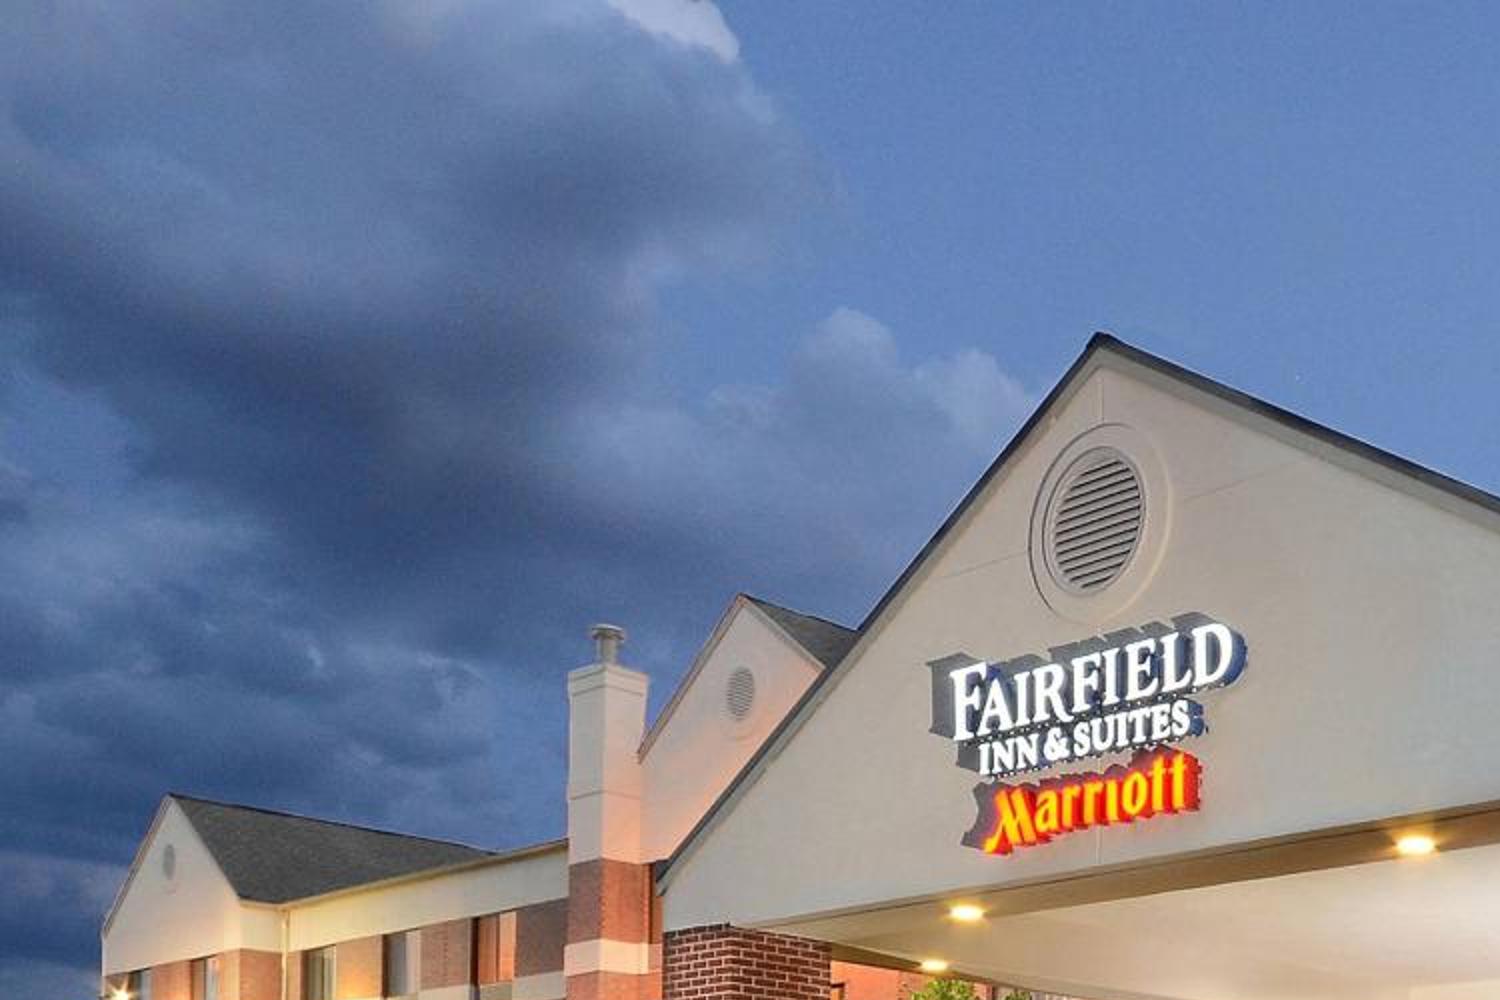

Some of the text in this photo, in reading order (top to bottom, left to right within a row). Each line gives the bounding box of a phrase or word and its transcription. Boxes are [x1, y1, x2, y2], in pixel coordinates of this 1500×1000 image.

[949, 622, 1234, 742] FAIRFIELD
[978, 699, 1191, 776] INN & SUITES
[983, 752, 1189, 854] Marriott
